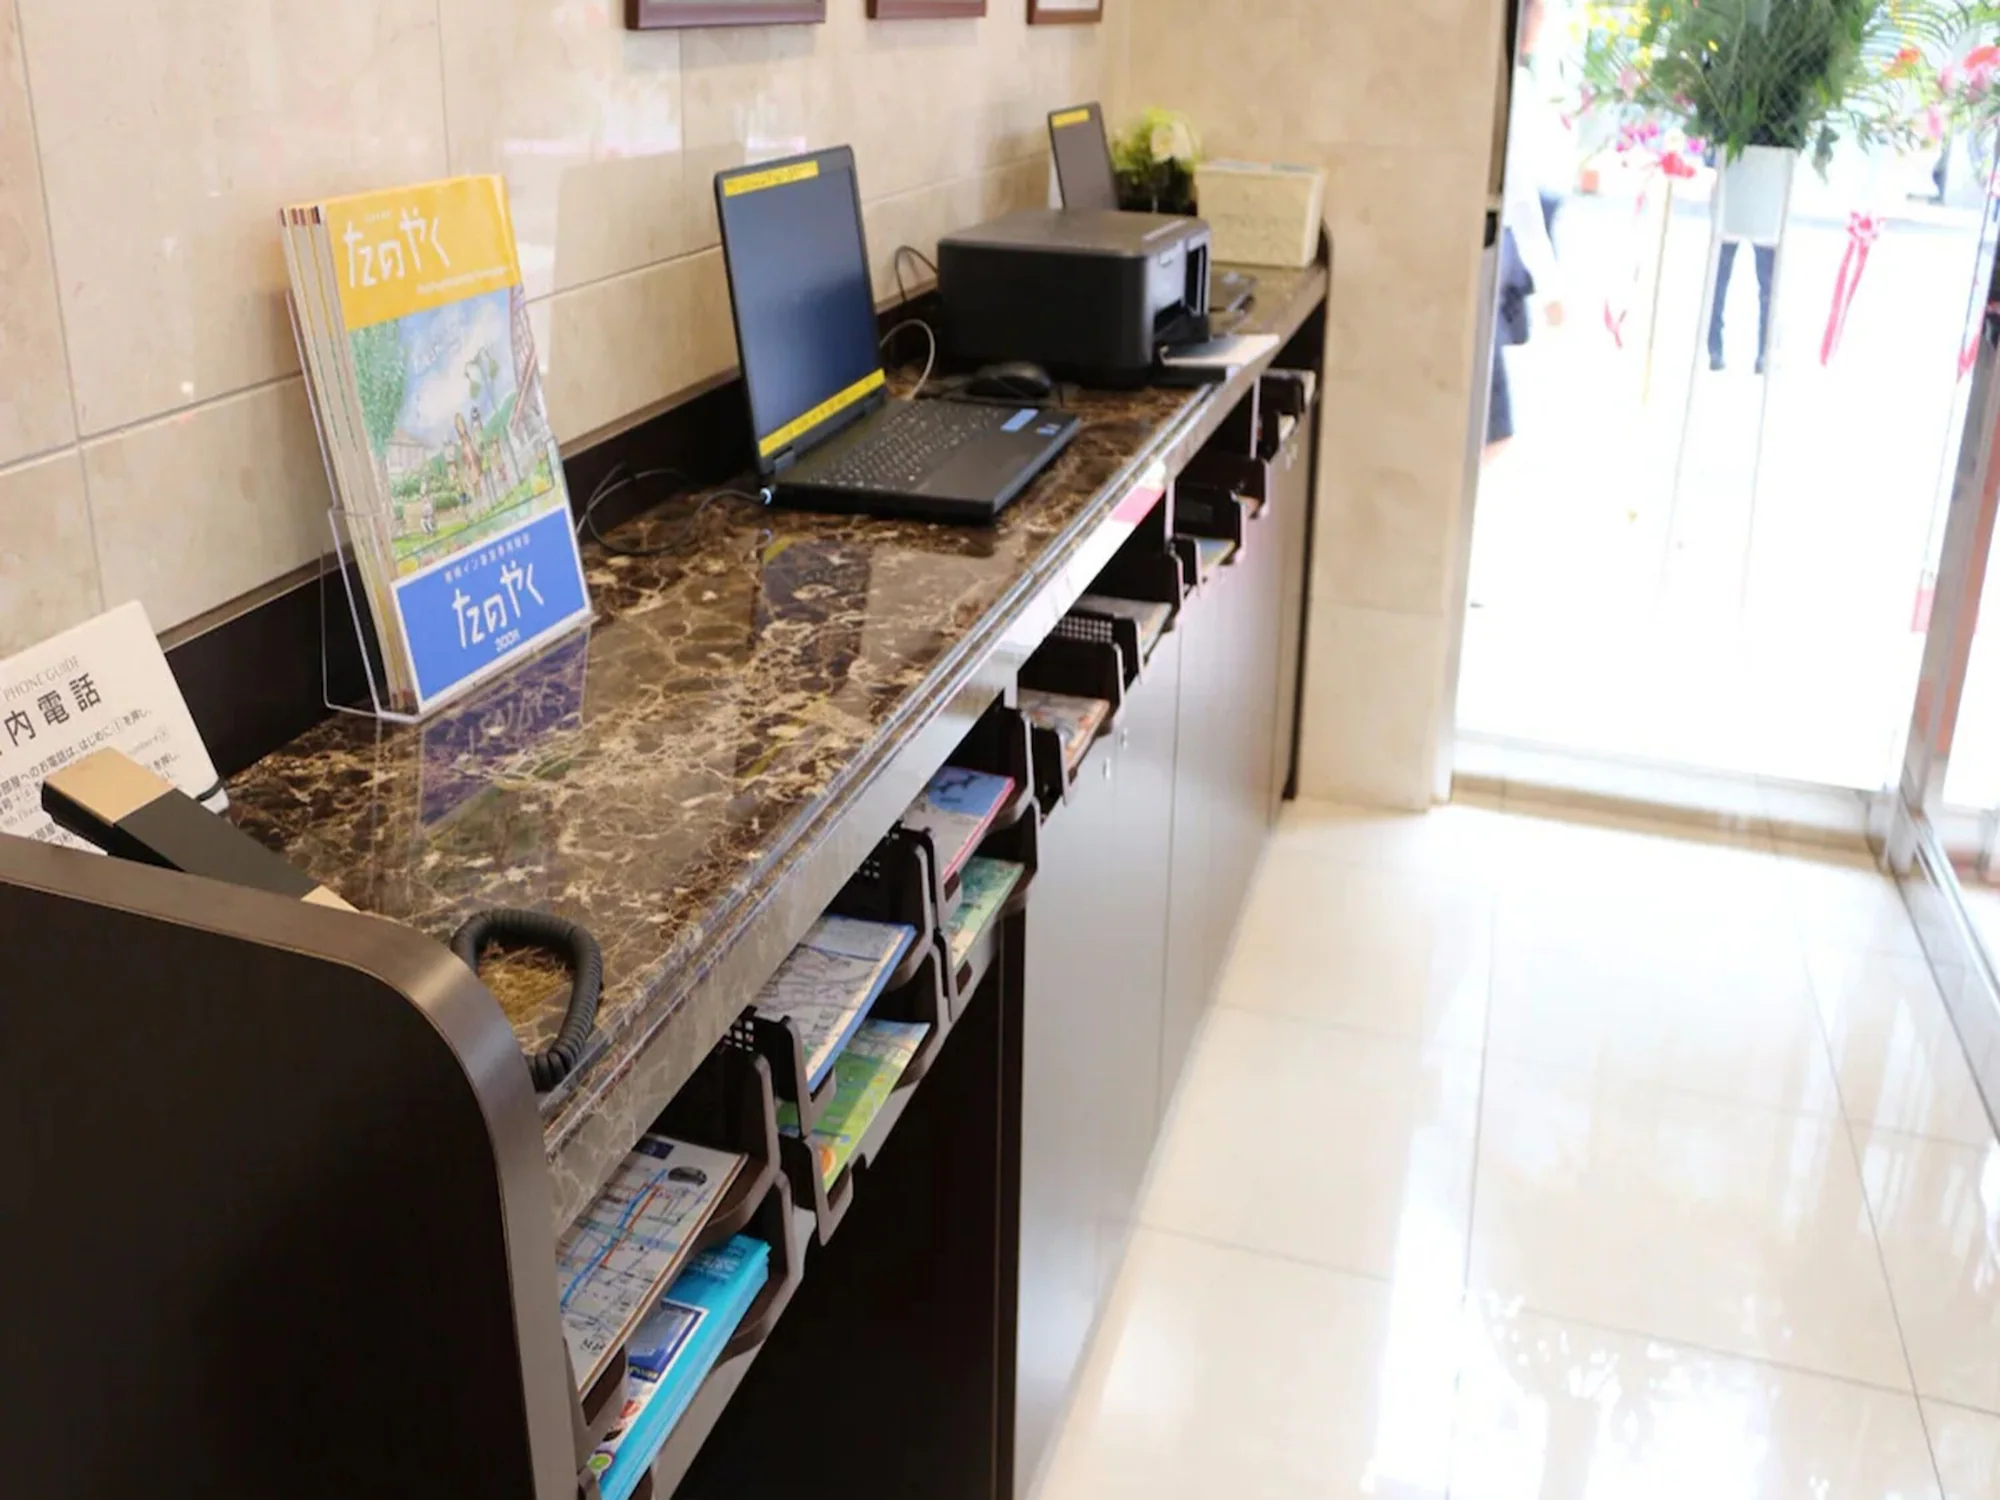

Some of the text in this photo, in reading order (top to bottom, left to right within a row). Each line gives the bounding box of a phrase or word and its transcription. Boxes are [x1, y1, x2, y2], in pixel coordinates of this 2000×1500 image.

[342, 206, 451, 289] たのやく
[452, 560, 545, 649] たのやく
[0, 673, 102, 756] 内電話
